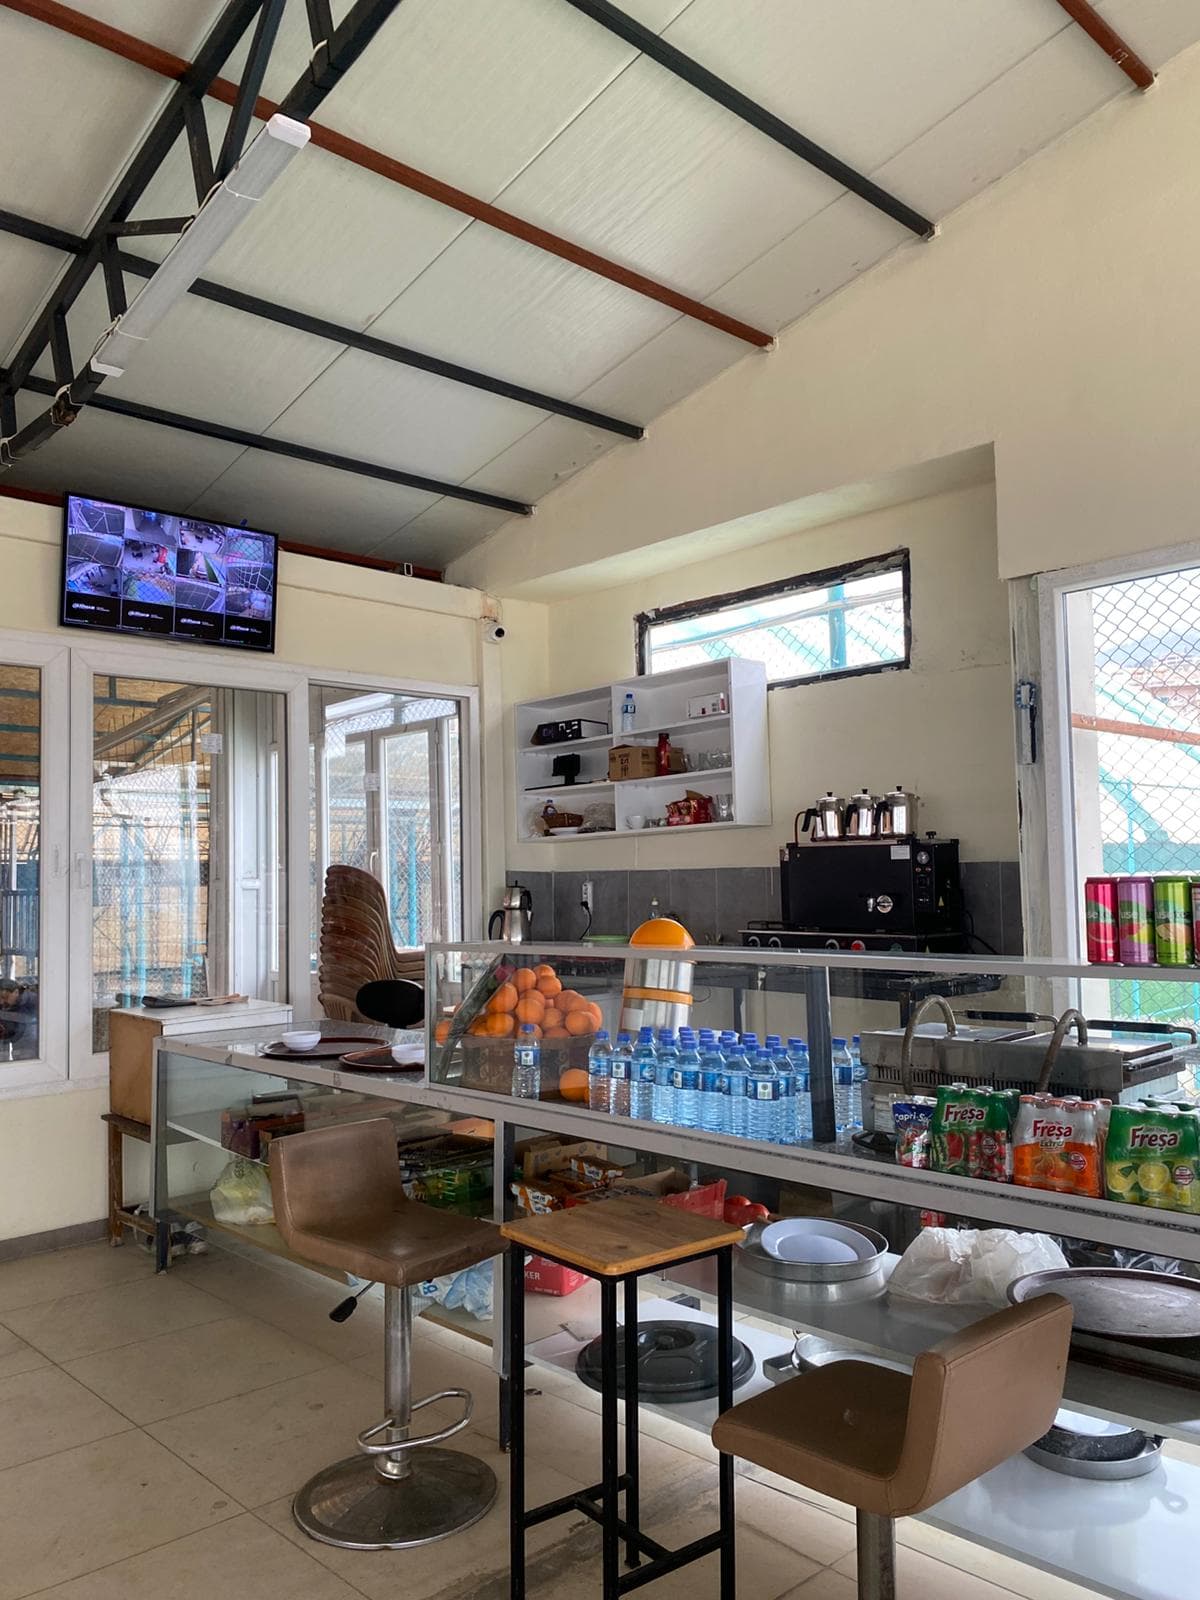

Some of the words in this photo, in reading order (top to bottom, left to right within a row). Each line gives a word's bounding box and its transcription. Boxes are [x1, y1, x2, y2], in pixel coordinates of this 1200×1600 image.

[944, 1104, 985, 1124] Freşa
[1032, 1119, 1073, 1140] Freşa
[1130, 1126, 1178, 1151] Freşa
